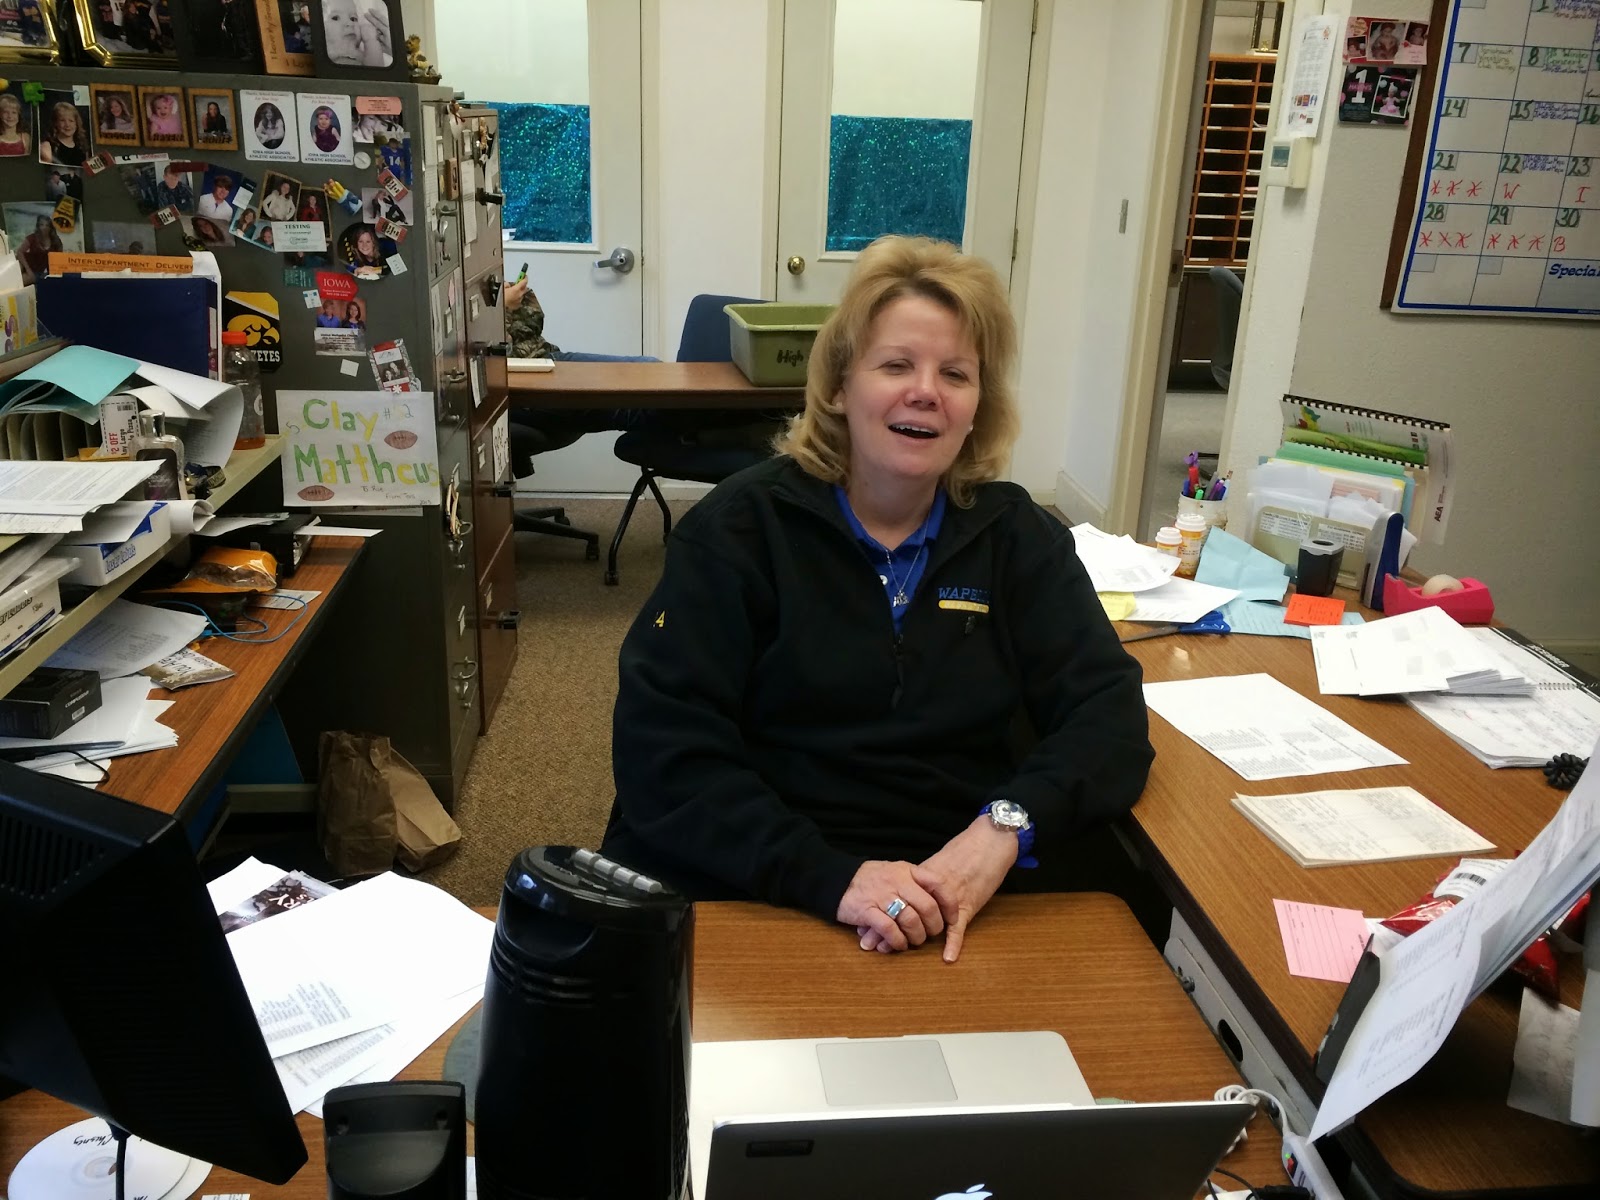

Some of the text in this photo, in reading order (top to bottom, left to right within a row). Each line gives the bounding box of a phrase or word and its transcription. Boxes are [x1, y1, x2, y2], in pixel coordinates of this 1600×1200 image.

[1458, 43, 1471, 63] 7
[1527, 46, 1540, 66] 8
[1440, 98, 1466, 118] 14
[1509, 100, 1534, 120] 15
[388, 155, 401, 167] 14
[1432, 152, 1456, 170] 21
[1499, 154, 1522, 174] 22
[1566, 157, 1591, 177] 23
[1503, 183, 1520, 200] W
[1424, 203, 1445, 221] 28
[1489, 205, 1510, 225] 29
[1555, 209, 1580, 228] 30
[1553, 236, 1566, 252] B
[323, 278, 351, 289] IOWA
[776, 349, 804, 367] High
[302, 398, 379, 442] Clay
[109, 432, 119, 446] OFF
[119, 428, 128, 445] Large
[1433, 506, 1445, 523] AEA
